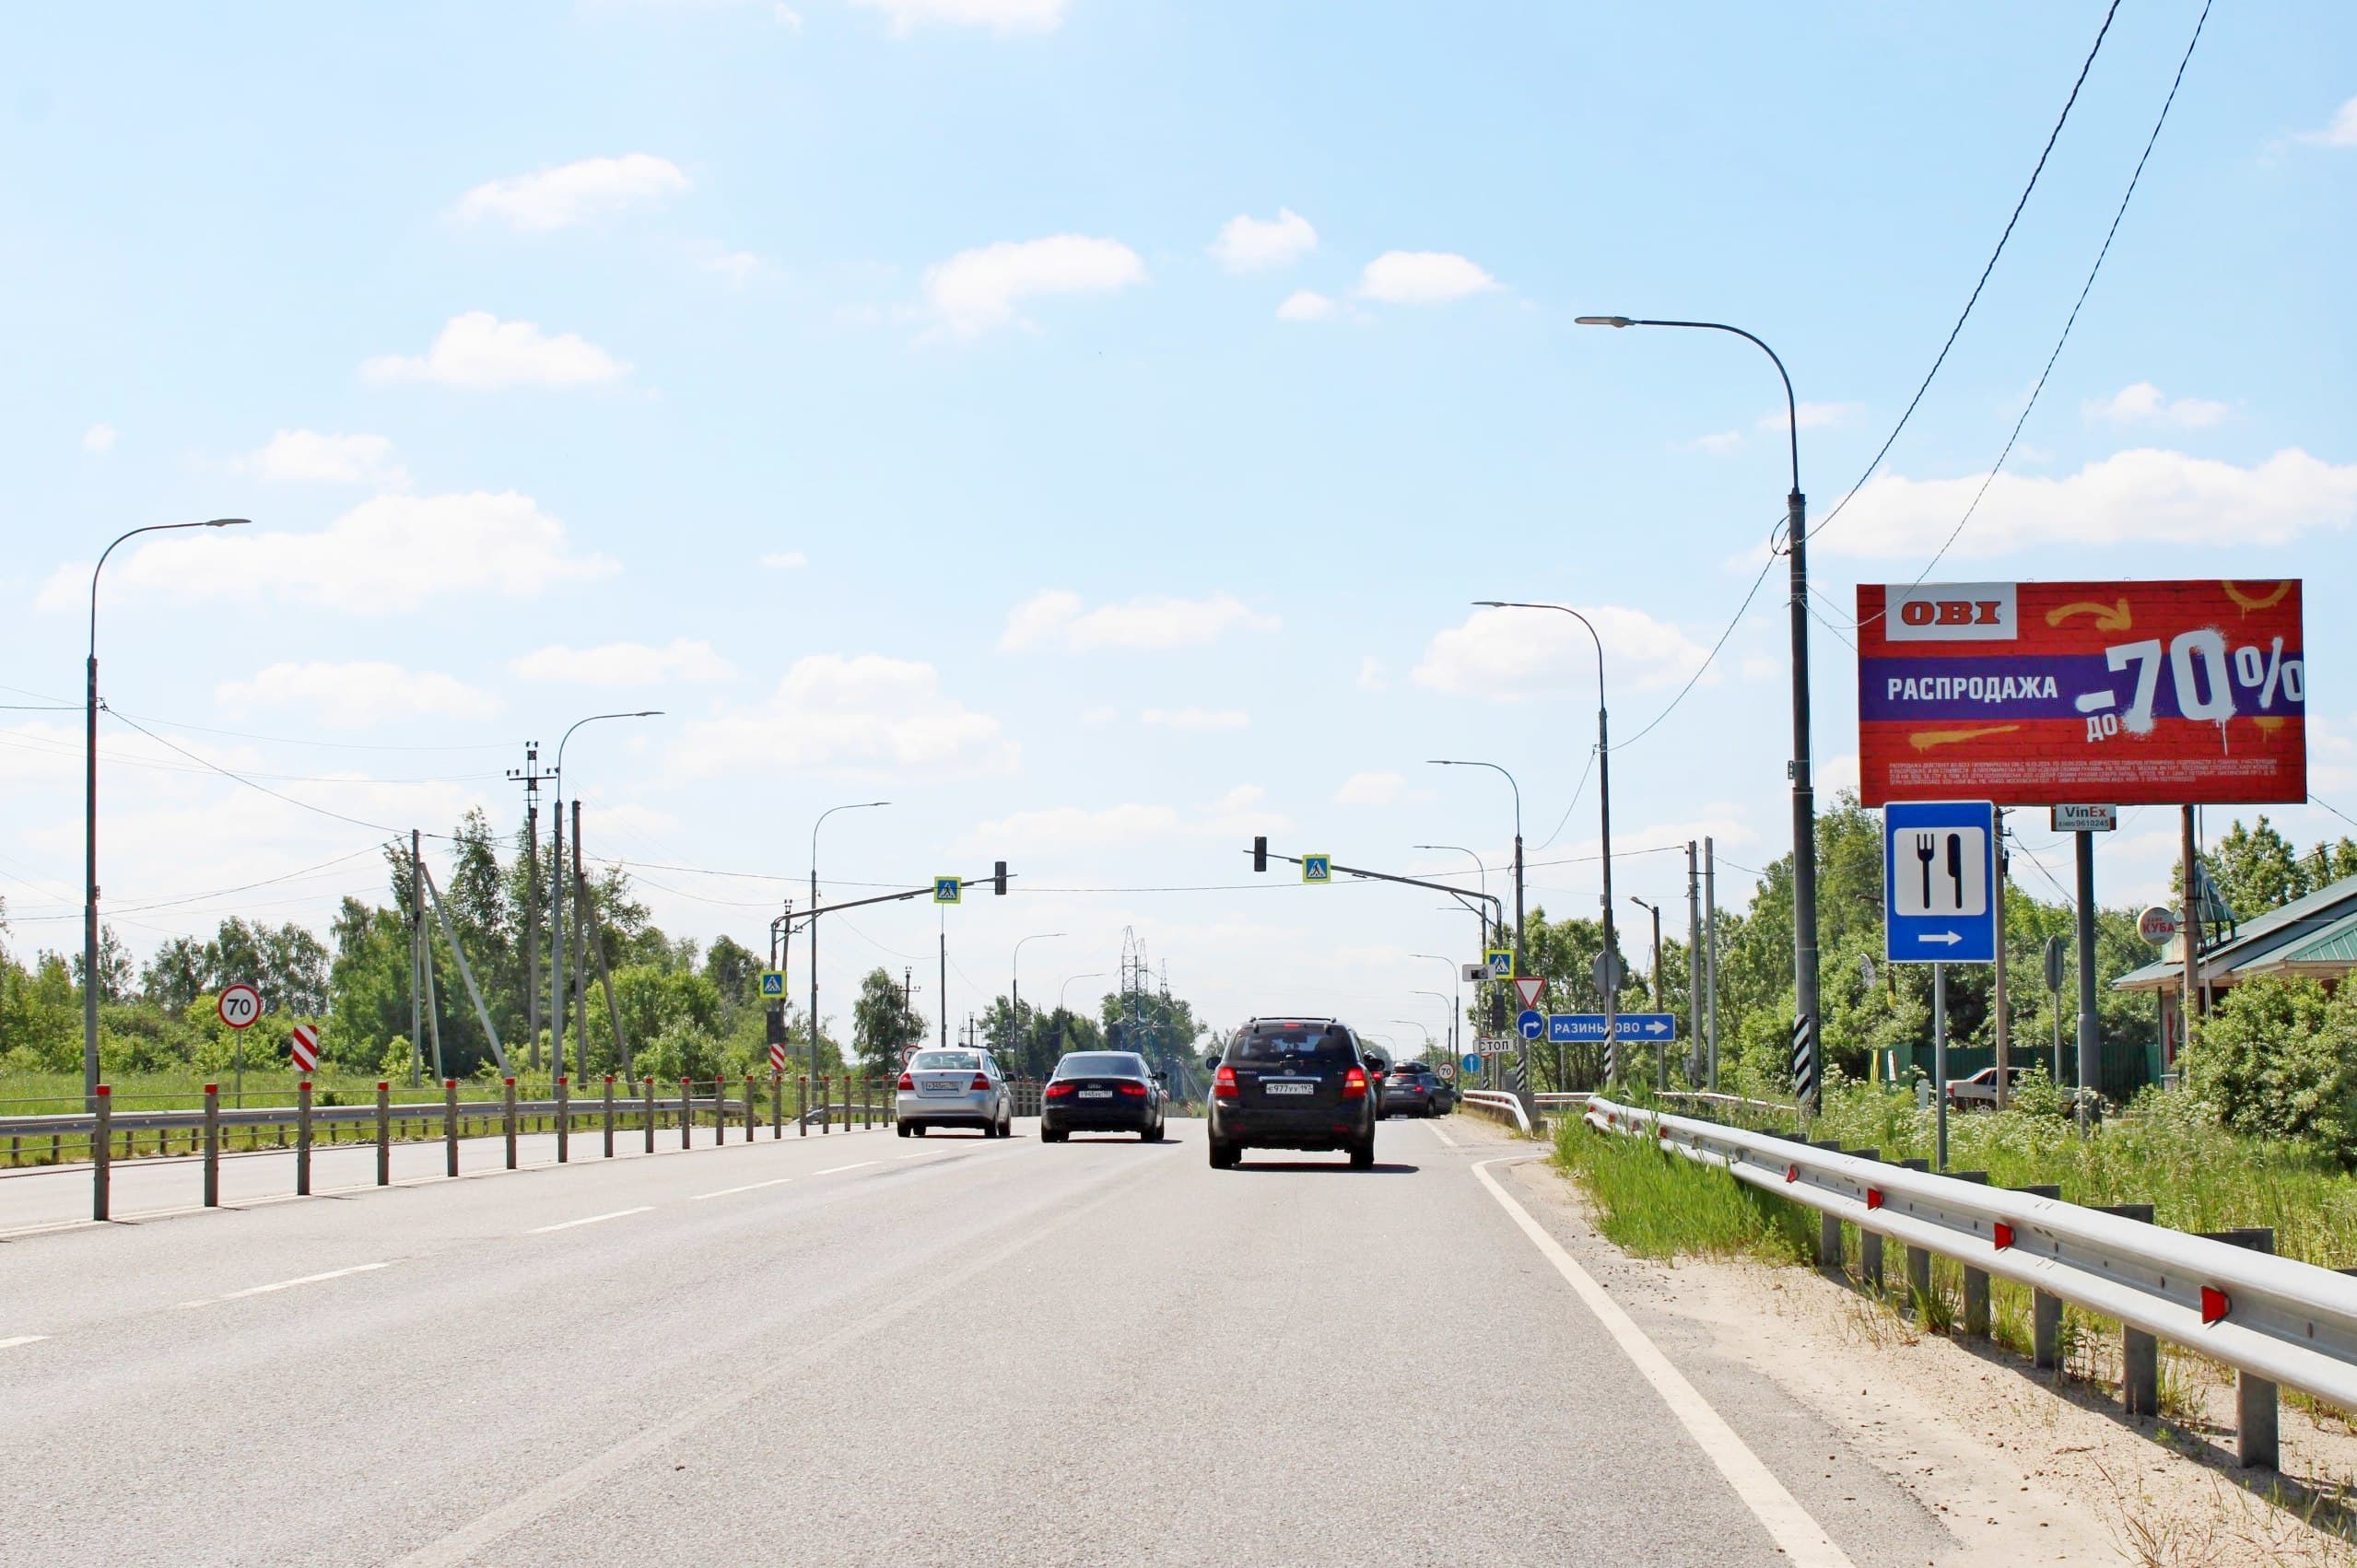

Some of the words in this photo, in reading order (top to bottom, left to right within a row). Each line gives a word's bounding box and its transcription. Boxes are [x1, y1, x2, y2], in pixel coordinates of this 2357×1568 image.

[1902, 601, 2001, 626] OBI
[1887, 676, 2058, 703] РАСПРОДАЖА
[2065, 806, 2106, 817] VinEx
[2143, 922, 2175, 933] КУБА
[228, 999, 251, 1015] 70
[1554, 1023, 1640, 1034] РАЗИНЬОВО
[1480, 1040, 1508, 1051] СТОП
[1441, 1068, 1451, 1076] 70
